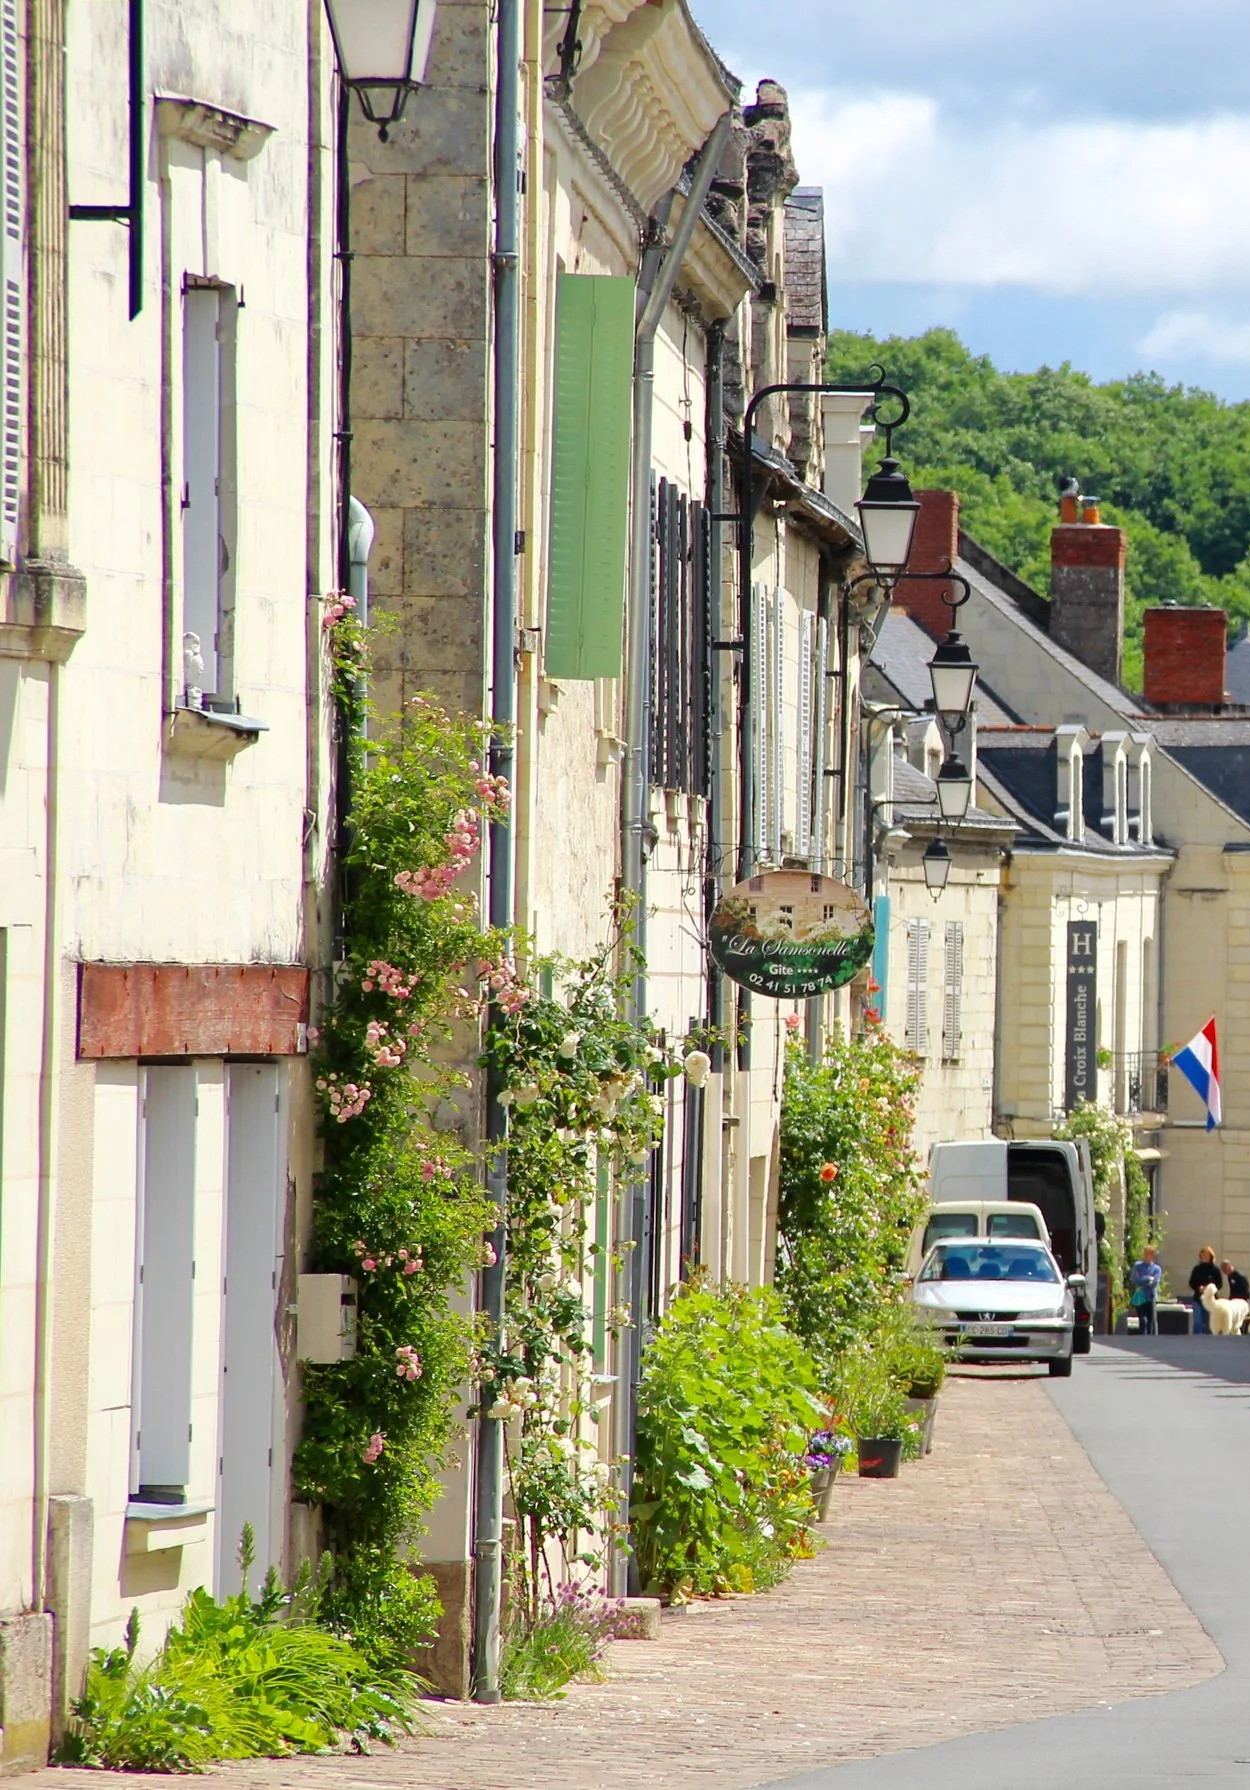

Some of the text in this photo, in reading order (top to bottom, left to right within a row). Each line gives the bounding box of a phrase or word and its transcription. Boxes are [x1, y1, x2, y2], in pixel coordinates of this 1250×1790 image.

[1071, 933, 1092, 956] H
[749, 973, 833, 994] 02 41 51 78 74
[1073, 984, 1087, 1042] Blanche
[1073, 1048, 1087, 1086] Croix
